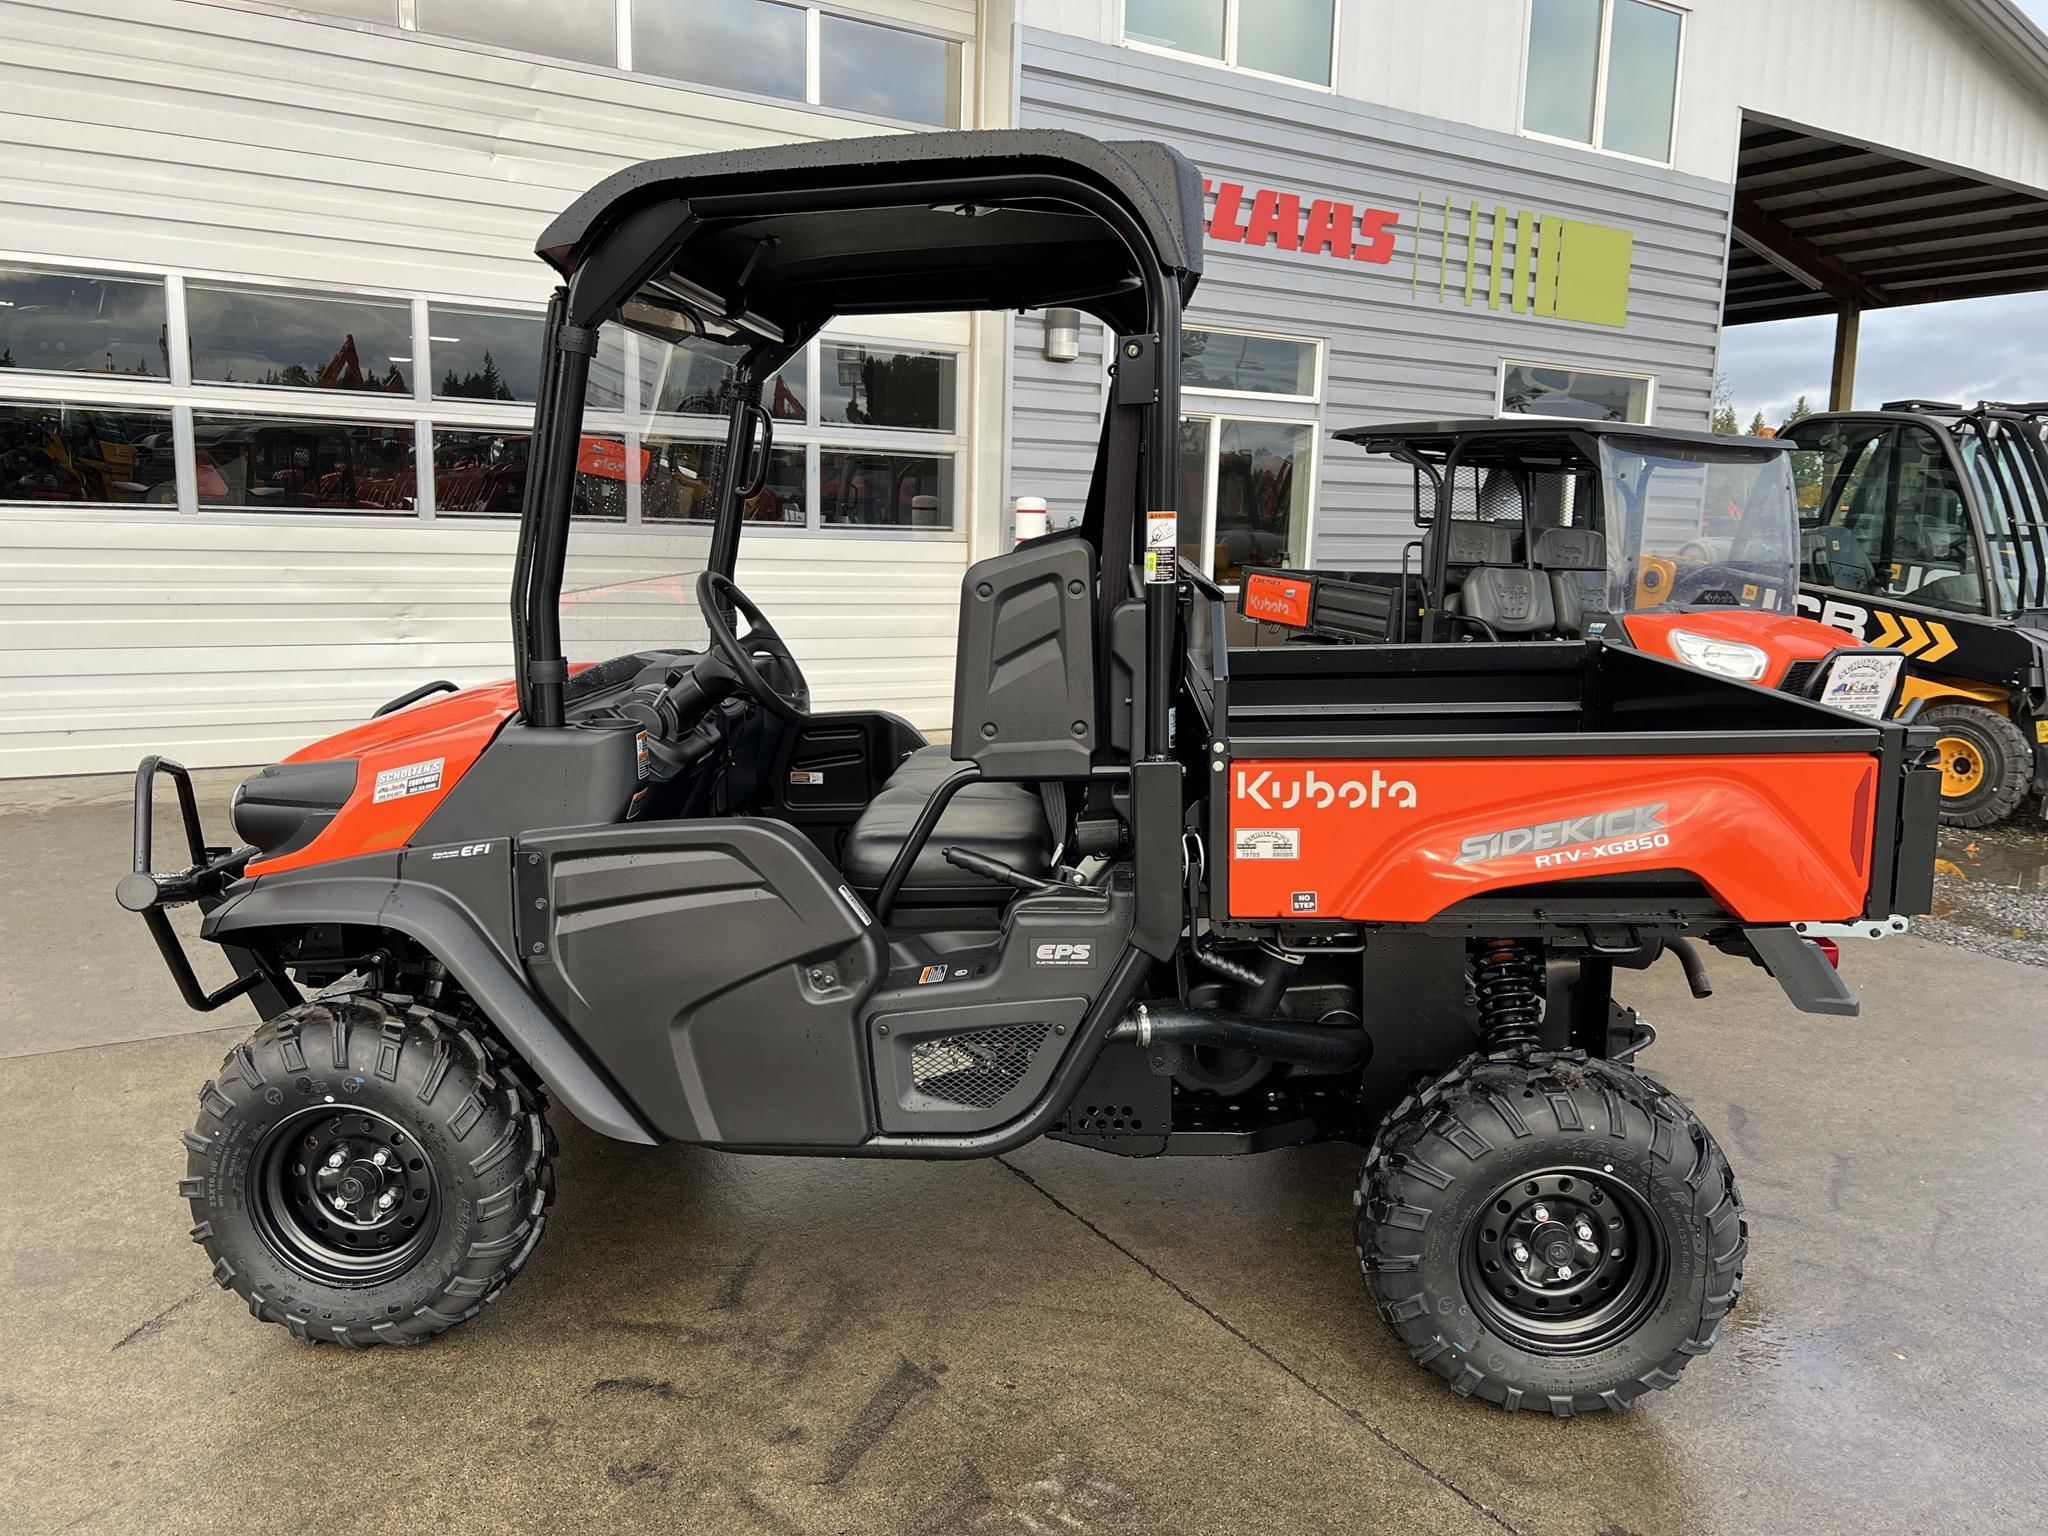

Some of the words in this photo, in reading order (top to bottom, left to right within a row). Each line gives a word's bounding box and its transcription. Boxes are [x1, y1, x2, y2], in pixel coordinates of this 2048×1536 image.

[1202, 180, 1399, 264] LAAS
[1249, 594, 1289, 615] Kubota
[379, 762, 441, 785] SCHOLTEN'S
[1237, 769, 1418, 810] Kubota
[1452, 802, 1668, 866] SIDEKICK
[460, 843, 491, 857] EFI
[1535, 833, 1670, 869] RTV-XG850
[1294, 901, 1316, 910] STEP
[1298, 894, 1311, 902] NO
[1036, 944, 1091, 960] EPS
